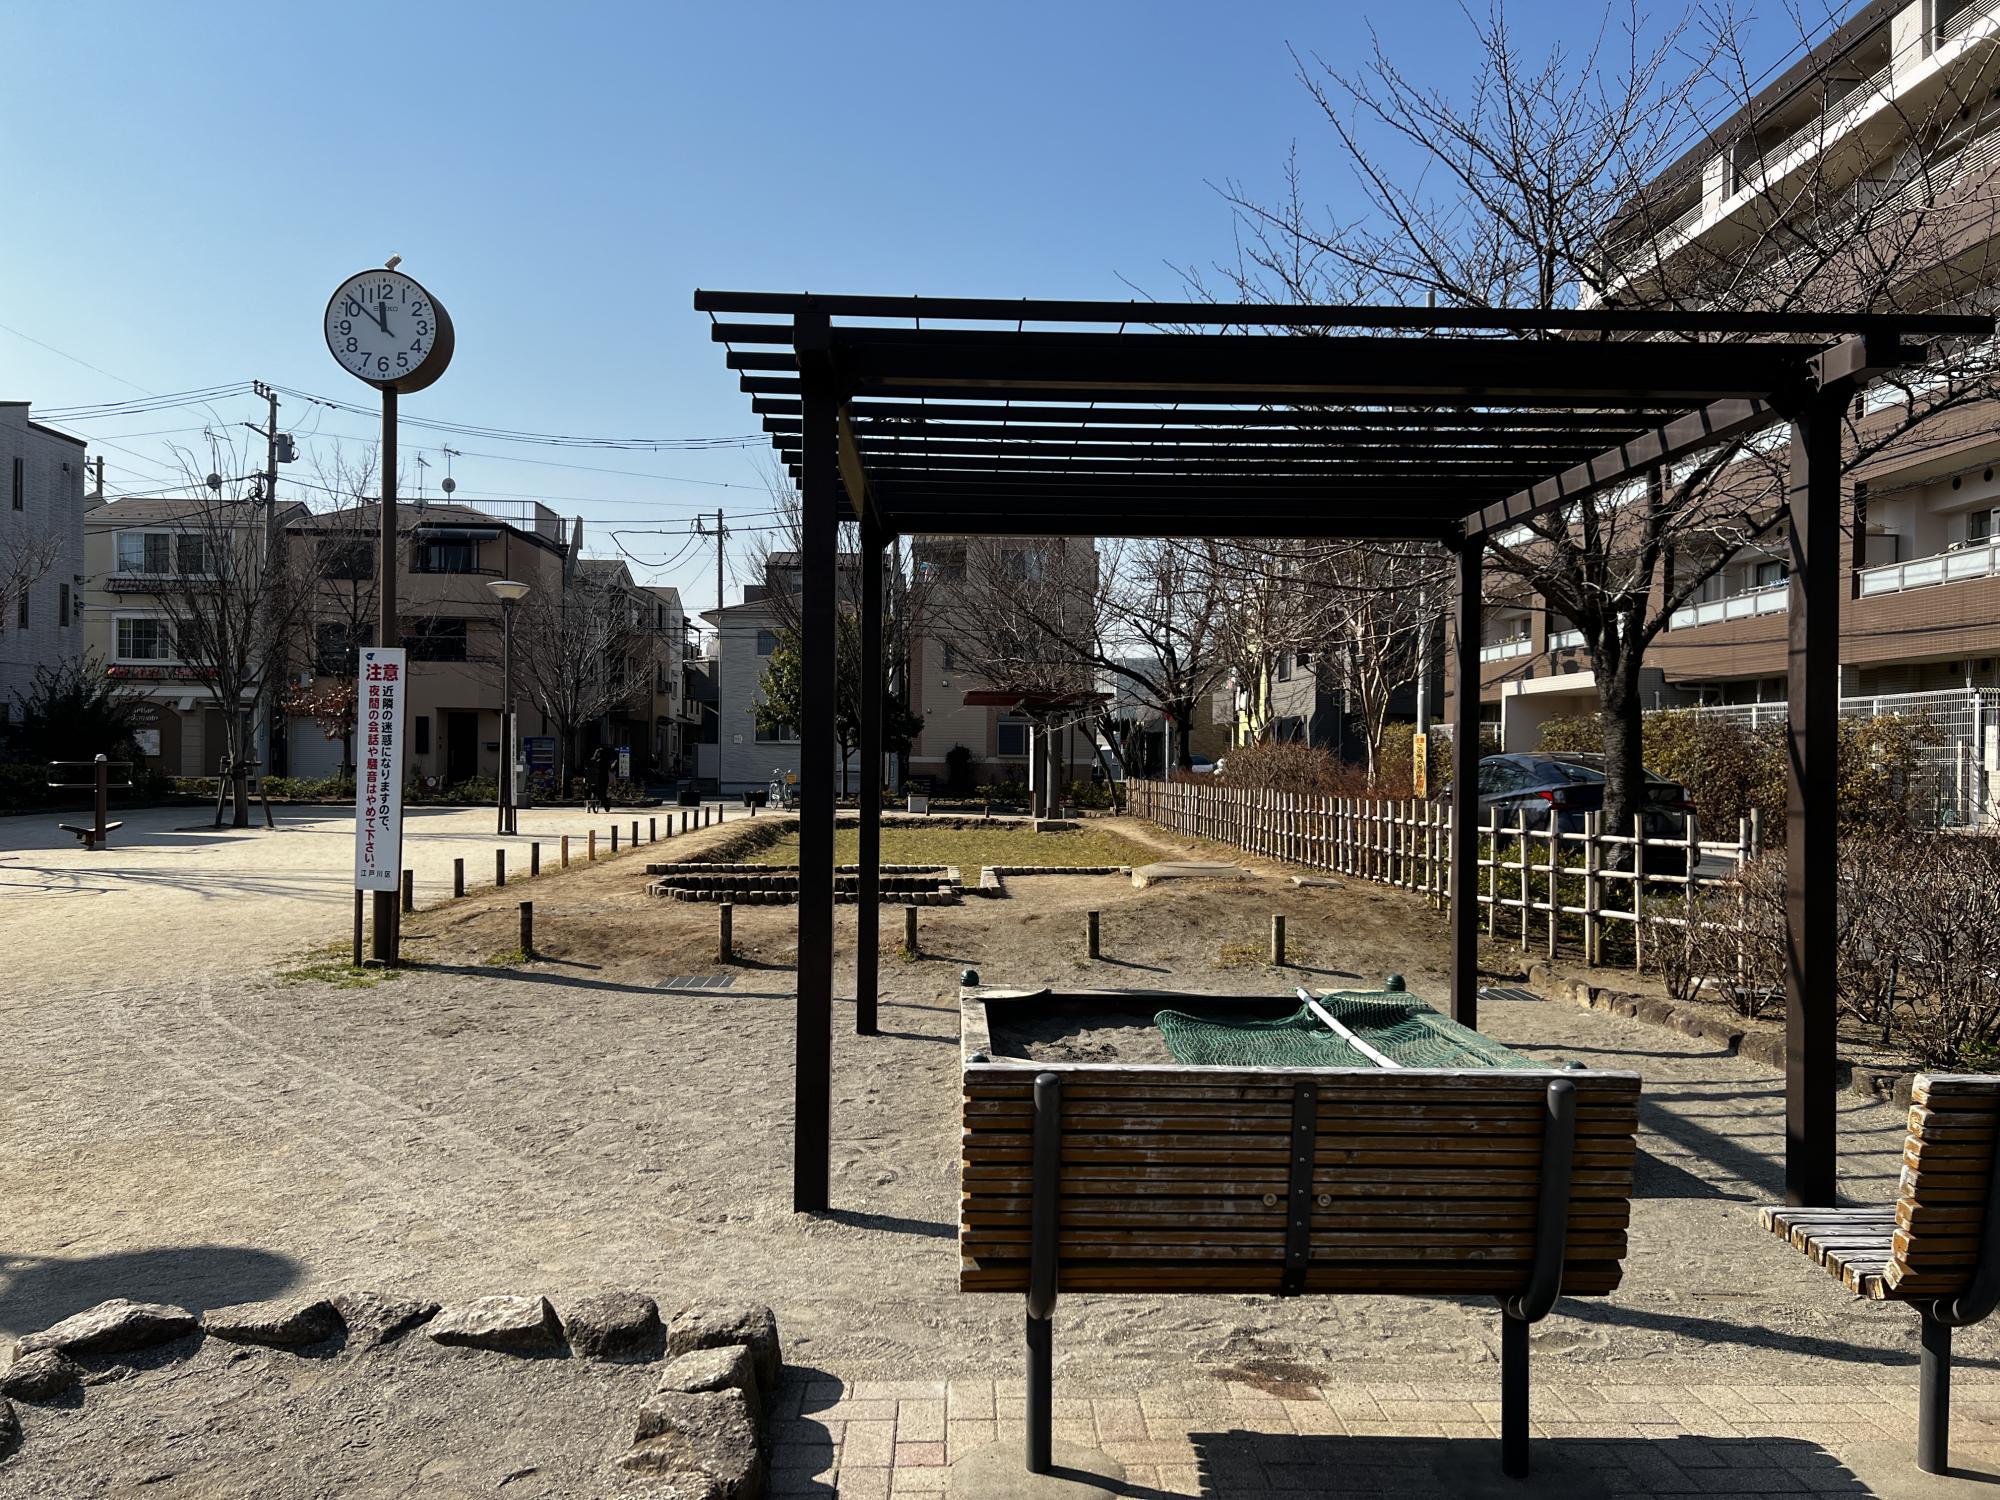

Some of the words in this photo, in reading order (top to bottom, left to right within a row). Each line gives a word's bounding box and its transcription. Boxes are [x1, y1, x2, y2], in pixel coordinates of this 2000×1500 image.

[361, 287, 373, 303] 11
[377, 284, 394, 300] 12
[402, 288, 406, 304] 1
[345, 301, 361, 317] 10
[411, 301, 423, 317] 2
[340, 320, 352, 335] 9
[416, 320, 428, 336] 3
[346, 337, 358, 353] 8
[410, 338, 422, 353] 4
[360, 352, 372, 367] 7
[377, 356, 389, 372] 6
[396, 352, 408, 367] 5
[366, 663, 399, 681] 注意
[379, 685, 394, 832] 近隣の迷惑になりますので、
[364, 685, 380, 868] 夜間の会話や騒音はやめて下さい。
[360, 870, 391, 878] 江戸川区
